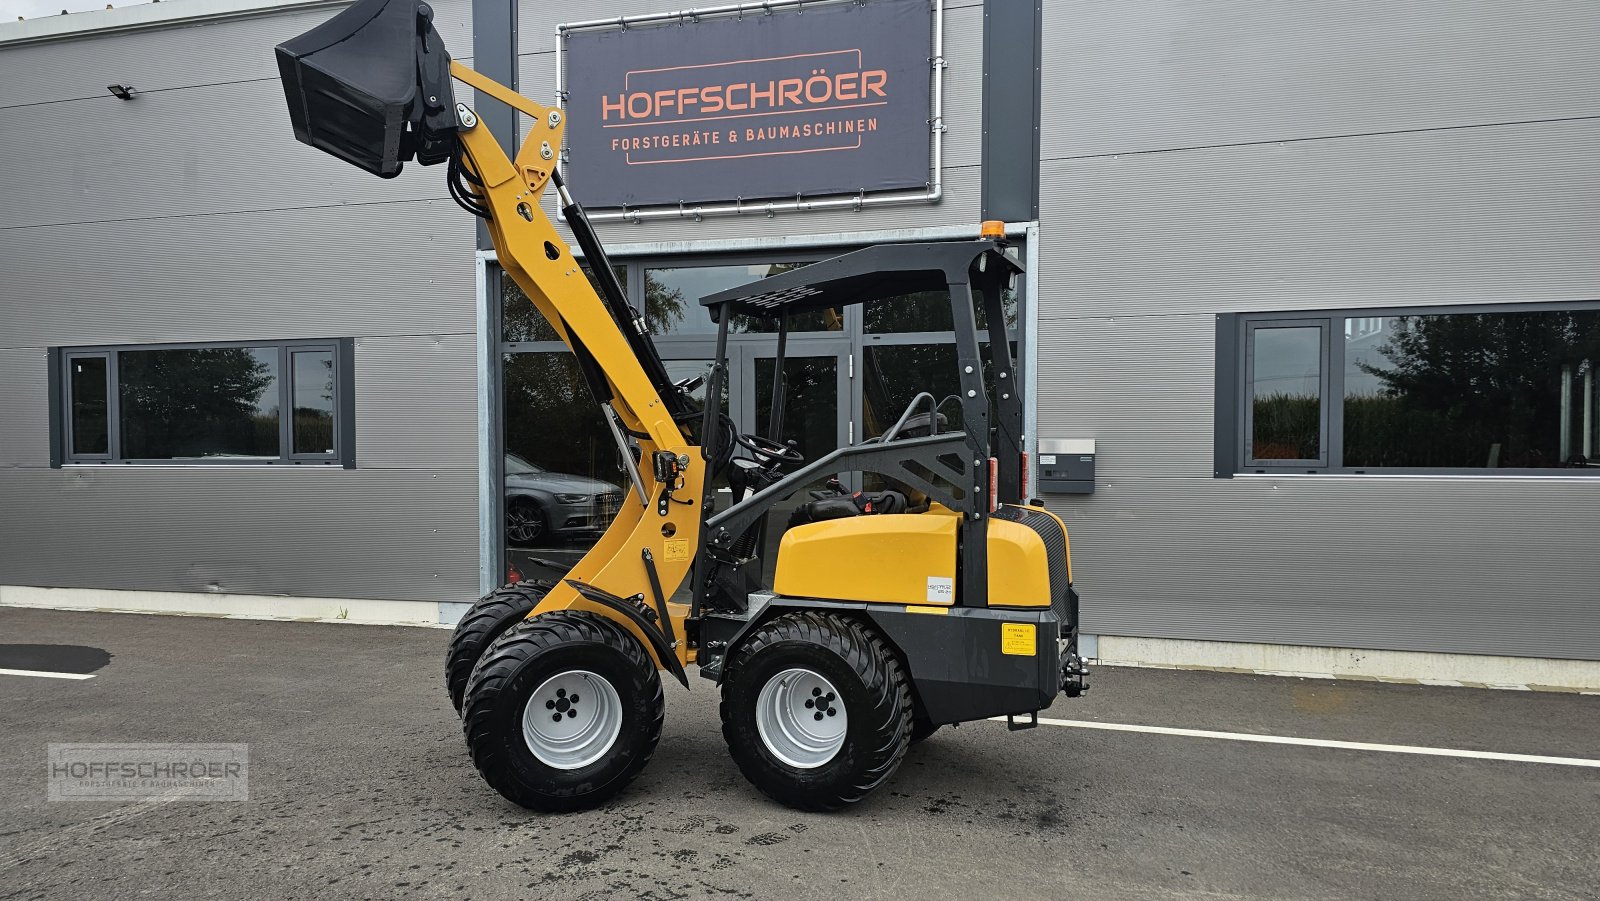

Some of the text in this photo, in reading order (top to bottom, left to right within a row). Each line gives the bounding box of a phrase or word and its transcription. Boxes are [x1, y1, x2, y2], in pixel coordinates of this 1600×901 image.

[602, 69, 887, 120] HOFFSCHRÖER
[612, 118, 878, 151] FORSTGERÄTE & BAUMASCHINEN
